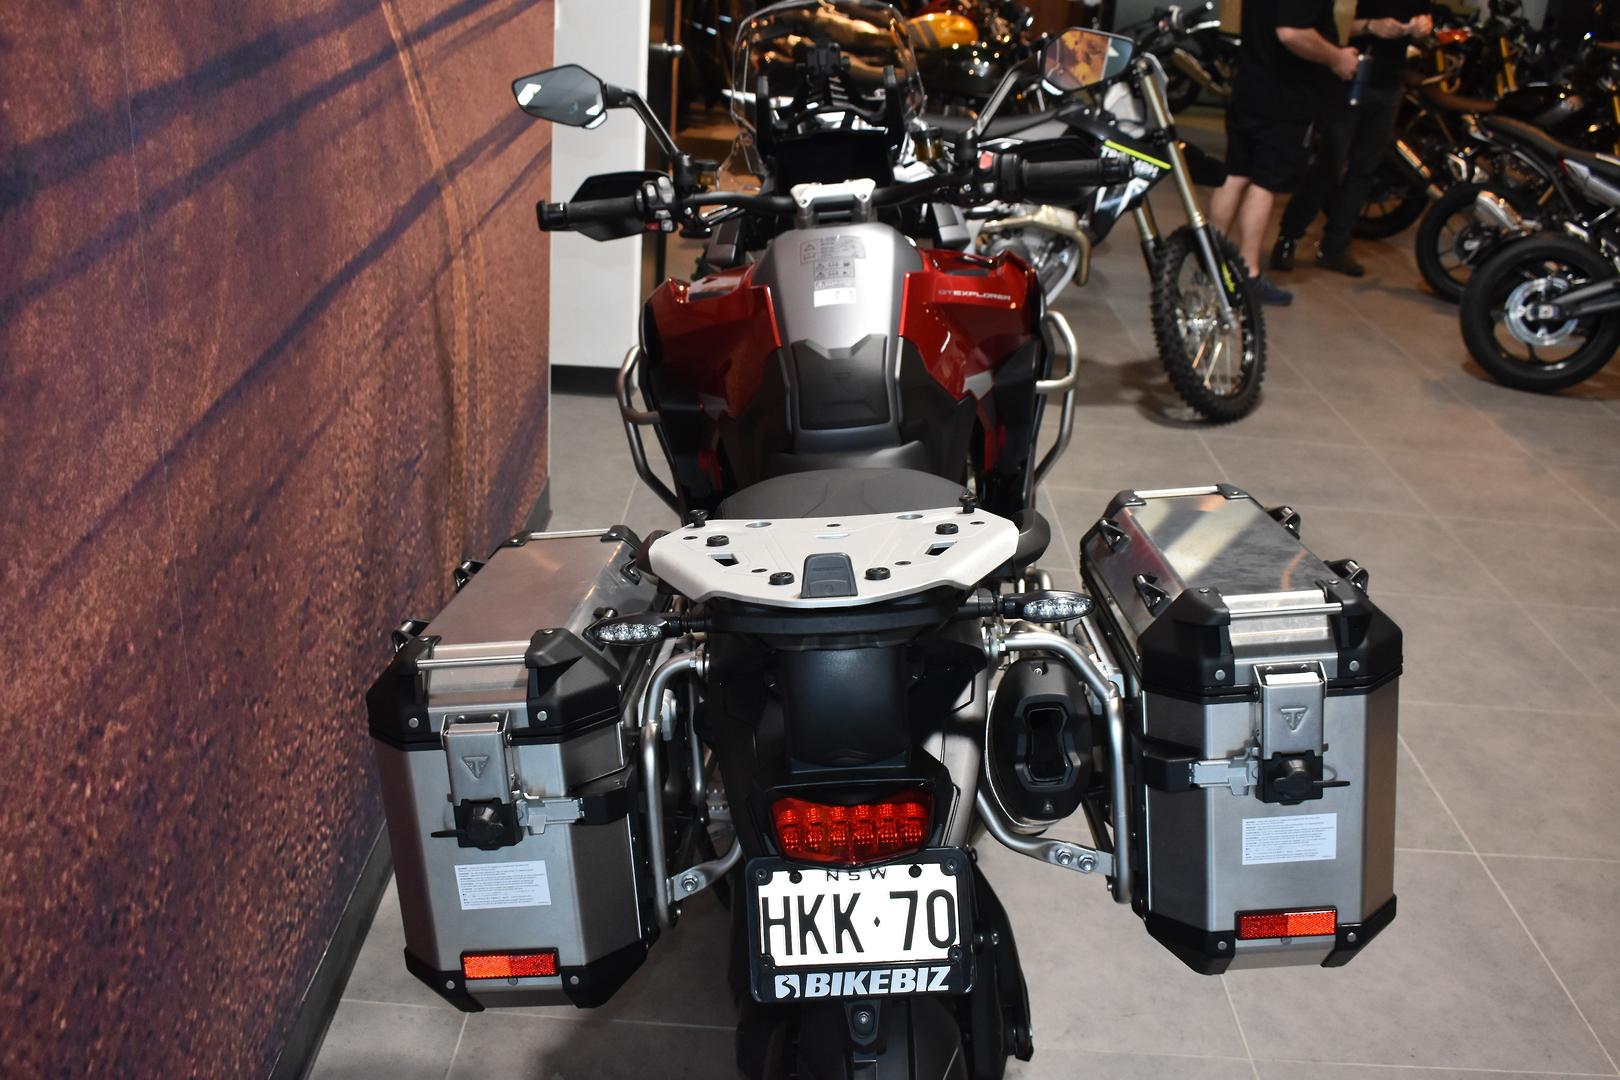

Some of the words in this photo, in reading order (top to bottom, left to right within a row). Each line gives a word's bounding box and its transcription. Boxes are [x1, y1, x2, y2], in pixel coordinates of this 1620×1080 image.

[826, 867, 887, 882] NSW
[762, 892, 864, 956] HKK
[889, 889, 957, 951] 70
[804, 966, 951, 998] BIKEBIZ
